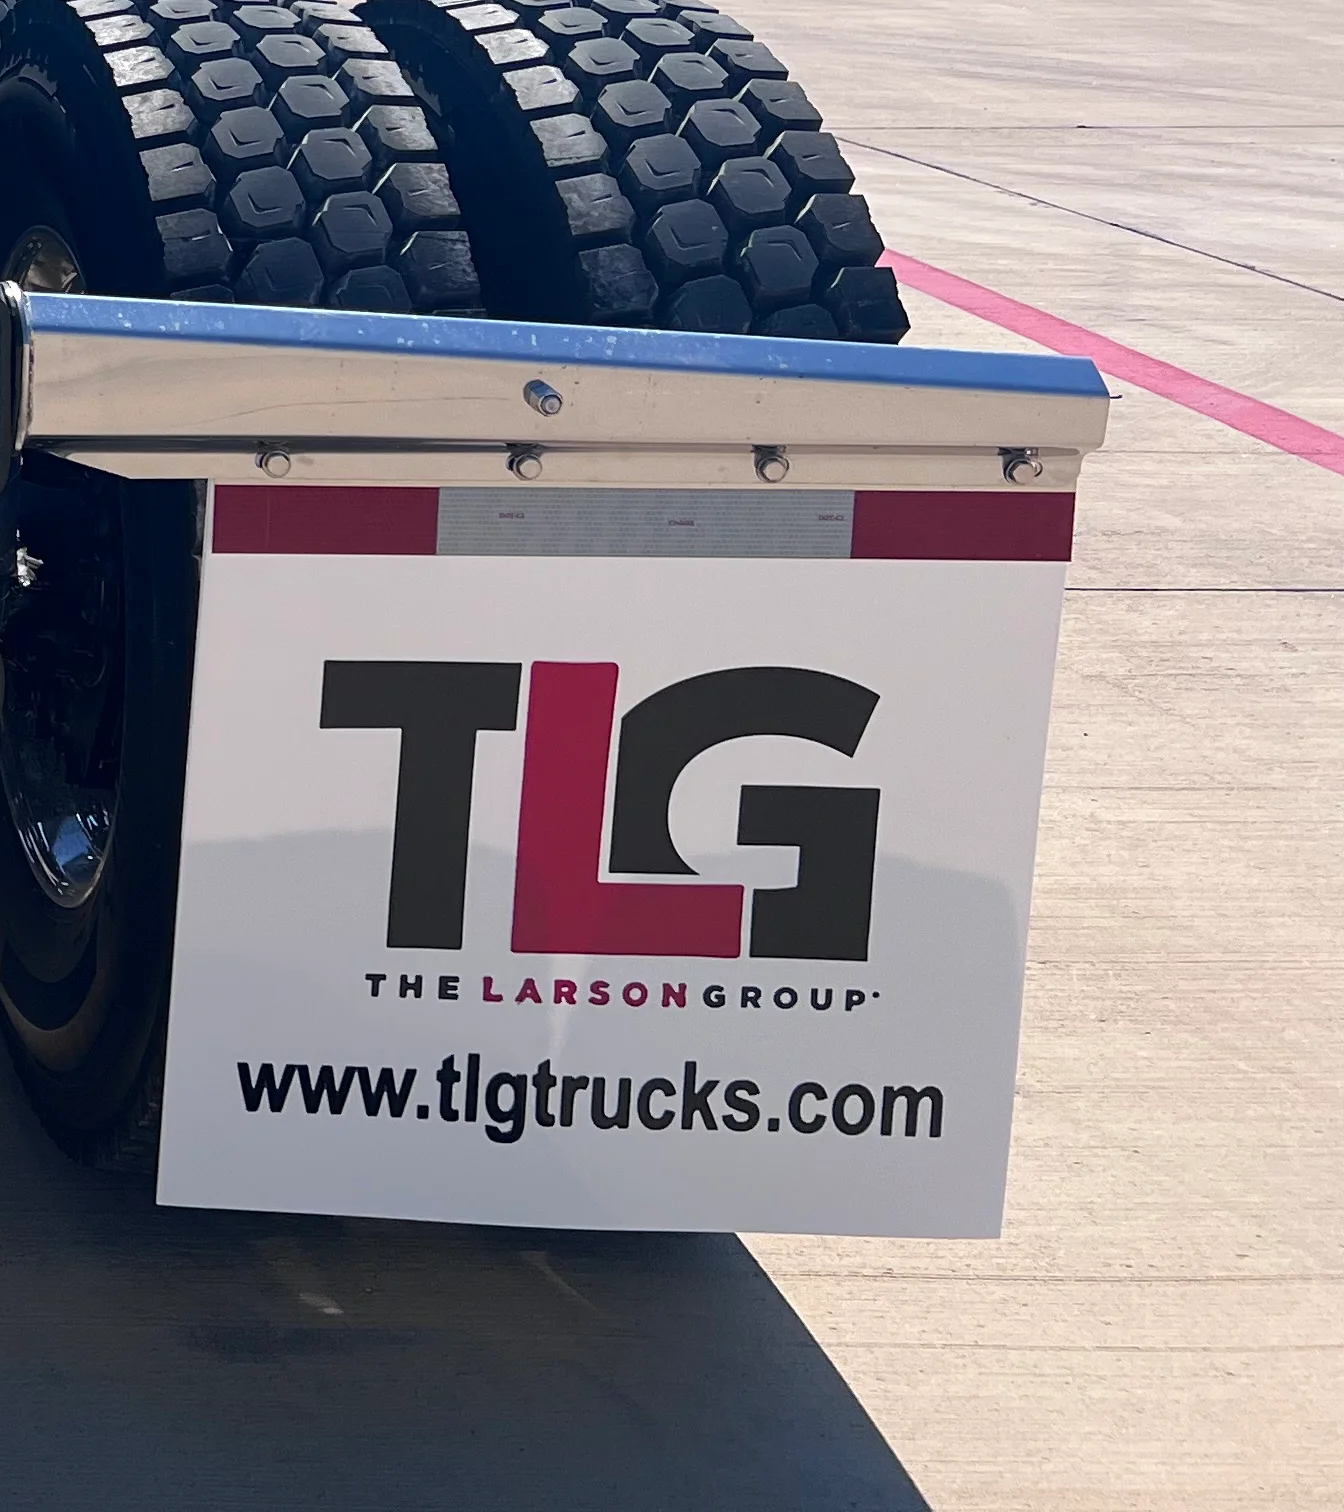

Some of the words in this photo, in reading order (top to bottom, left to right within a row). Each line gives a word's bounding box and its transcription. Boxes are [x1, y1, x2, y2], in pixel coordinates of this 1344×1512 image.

[319, 659, 881, 963] TLG
[364, 973, 460, 1001] THE
[482, 975, 688, 1009] LARSON
[236, 1052, 944, 1144] www.tlgtrucks.com
